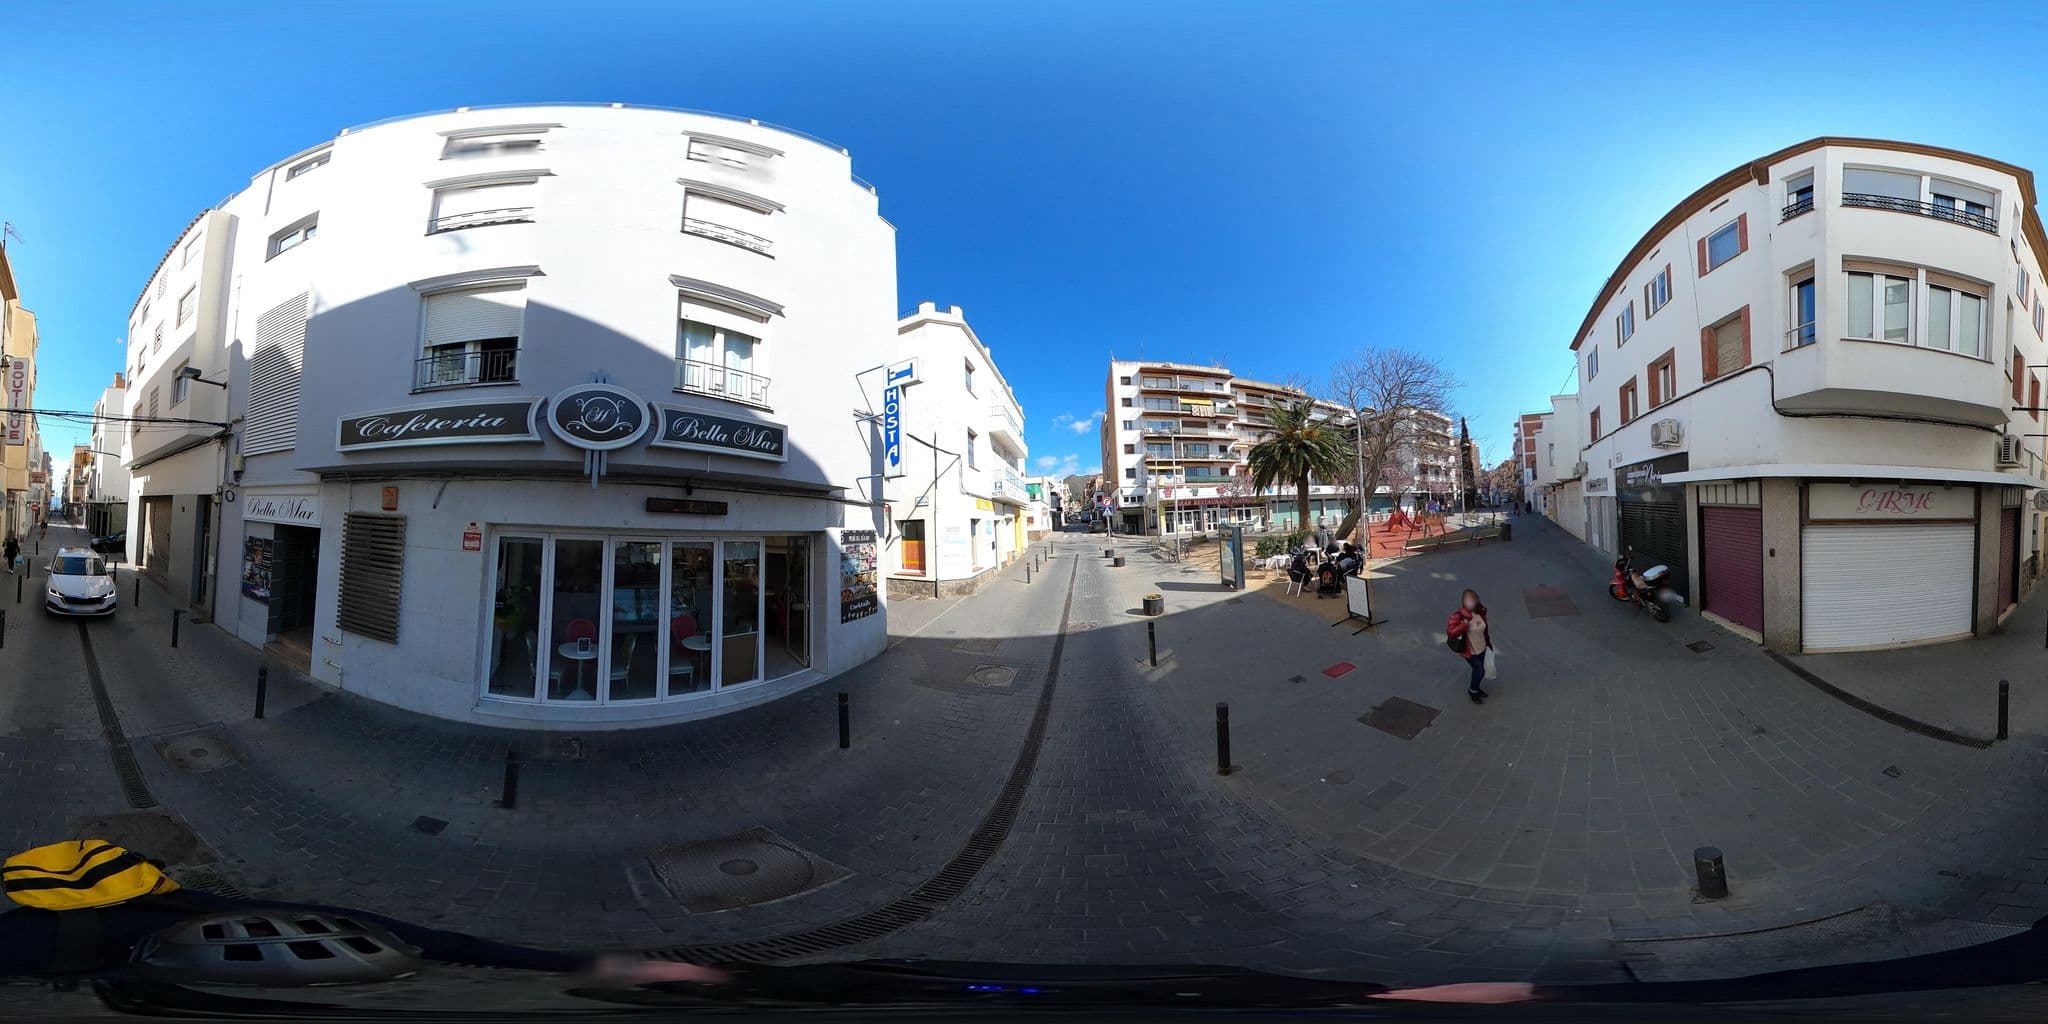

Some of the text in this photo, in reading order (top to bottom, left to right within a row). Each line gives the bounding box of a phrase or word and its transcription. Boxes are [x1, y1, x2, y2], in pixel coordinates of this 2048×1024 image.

[10, 361, 24, 440] BOUTIQUE
[355, 413, 508, 440] Cafeteria
[672, 416, 778, 451] Bella Mar
[248, 498, 314, 520] Bella Mar
[1856, 489, 1936, 514] CARME
